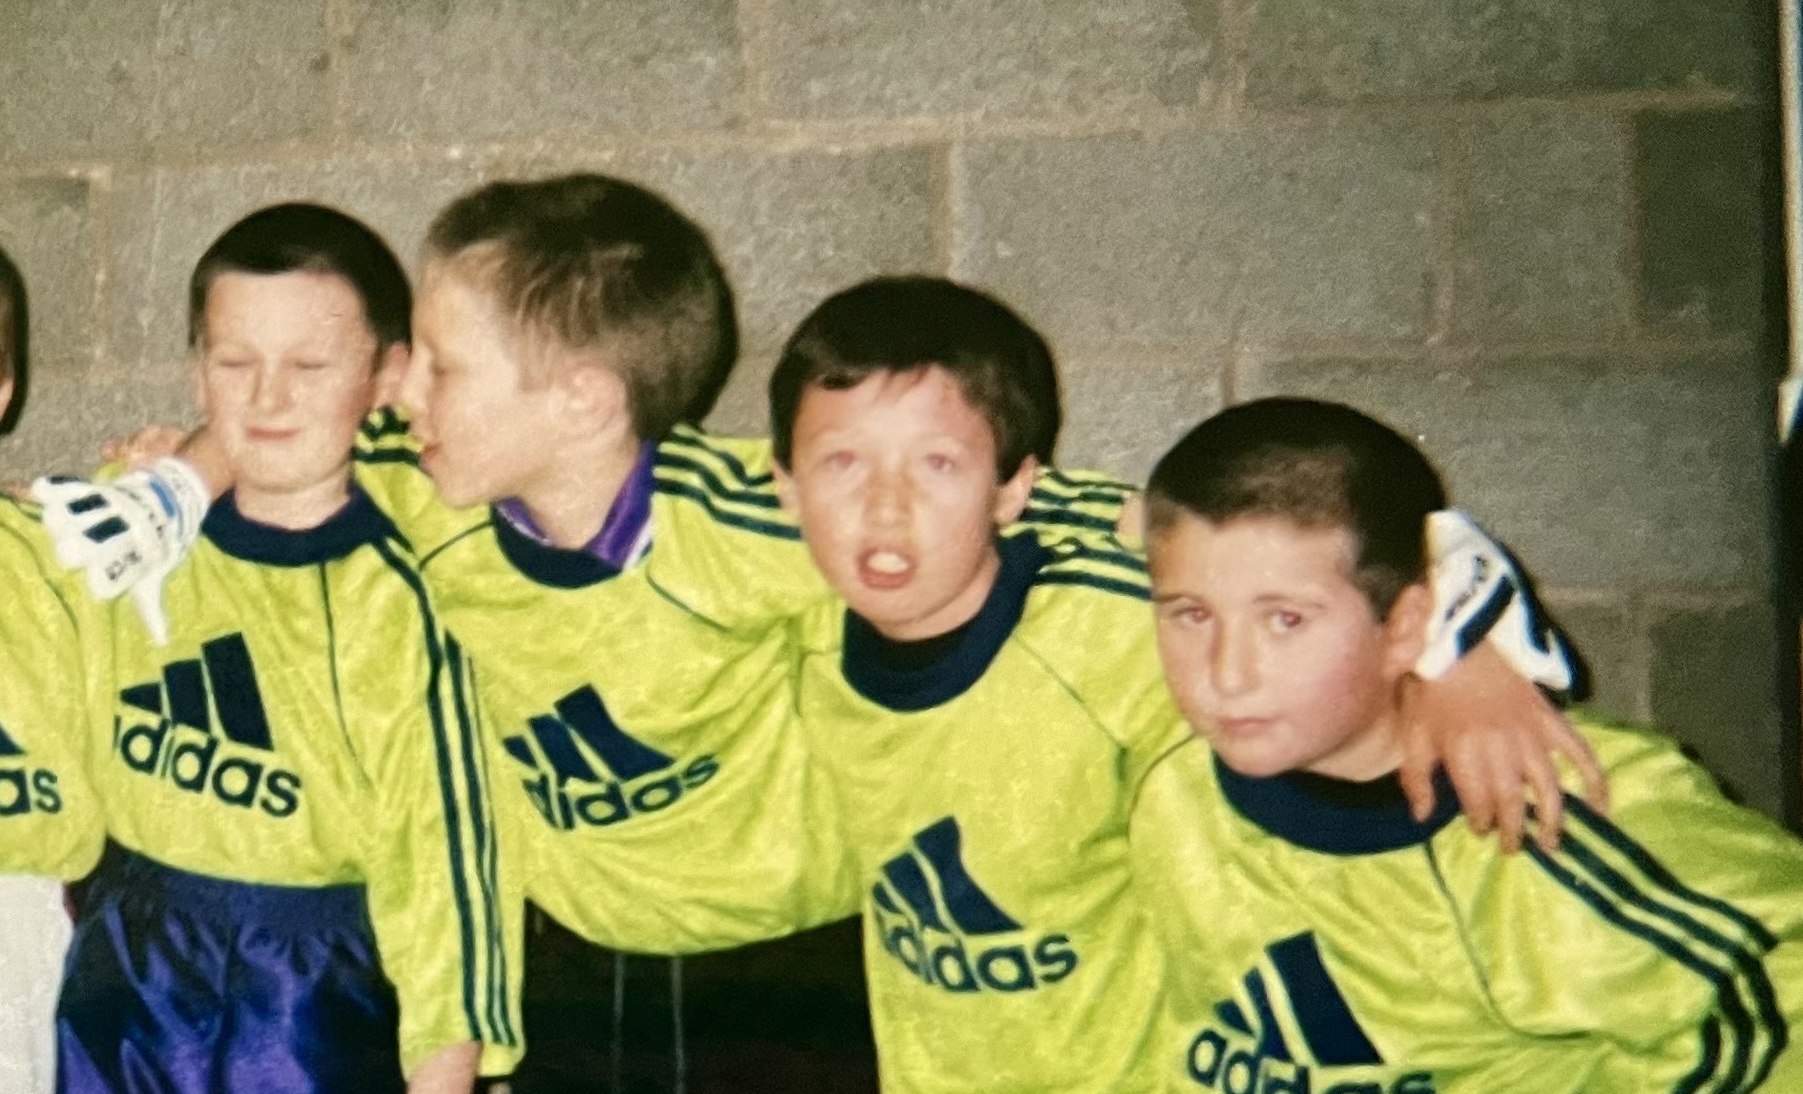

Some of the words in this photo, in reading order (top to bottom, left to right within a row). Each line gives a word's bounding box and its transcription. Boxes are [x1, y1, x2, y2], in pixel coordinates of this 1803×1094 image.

[113, 714, 302, 818] didas
[521, 753, 719, 830] didas
[878, 912, 1078, 992] didas
